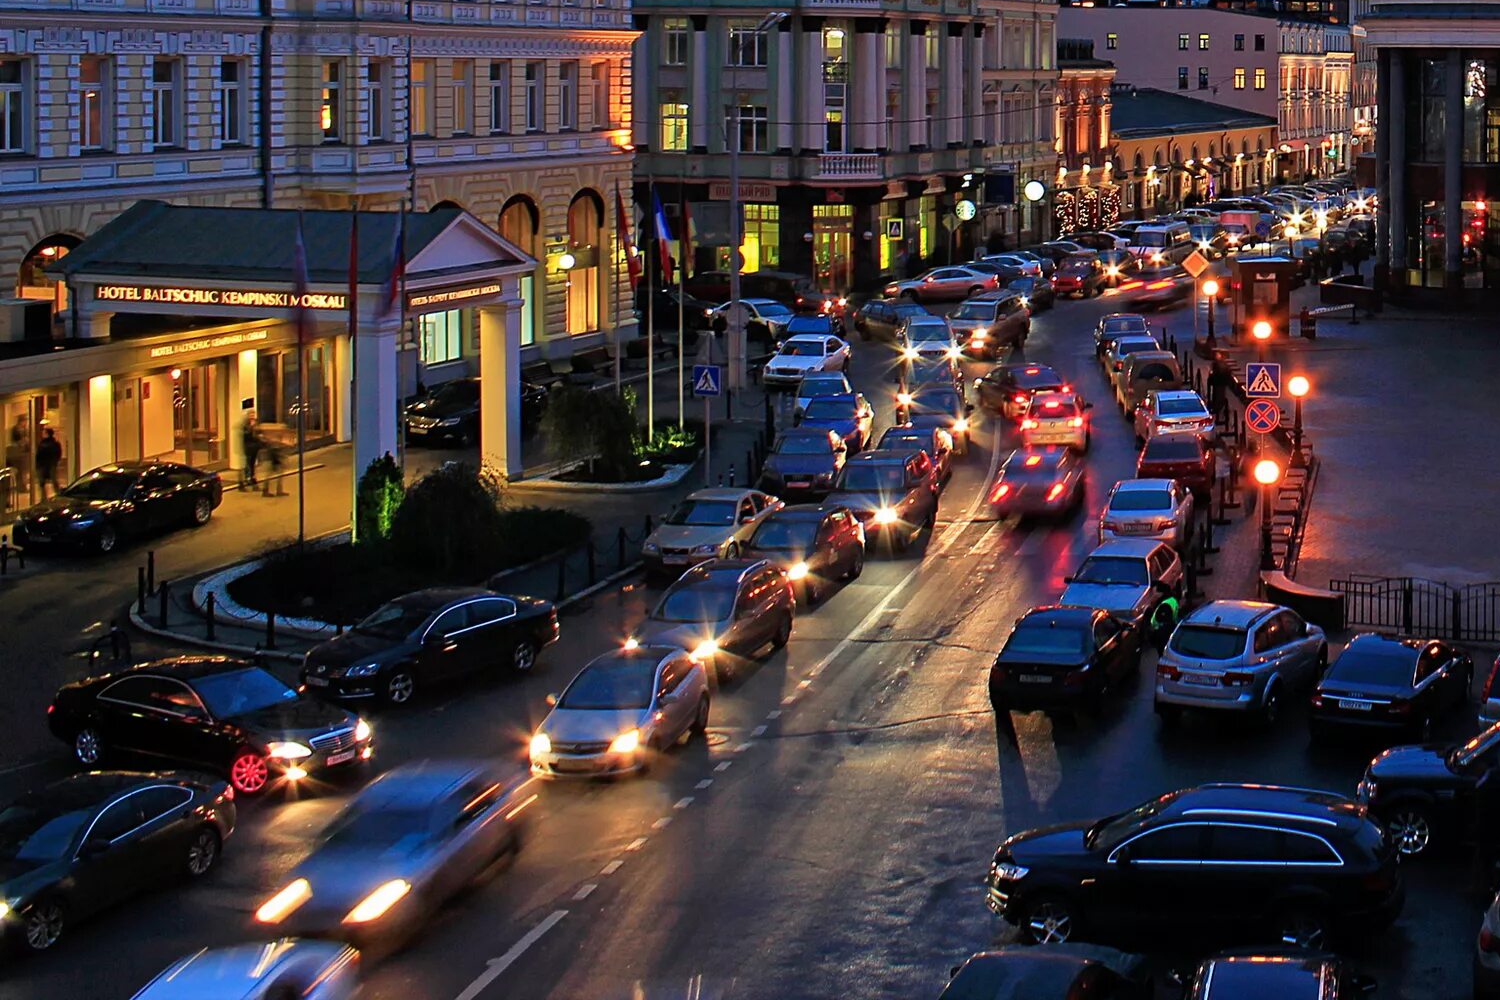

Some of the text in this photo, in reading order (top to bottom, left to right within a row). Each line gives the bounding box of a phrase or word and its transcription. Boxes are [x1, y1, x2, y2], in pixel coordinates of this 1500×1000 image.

[98, 286, 345, 308] HOTEL BALTSCHUG KEMPINSKI MOSKAU
[151, 345, 175, 357] HOTEL
